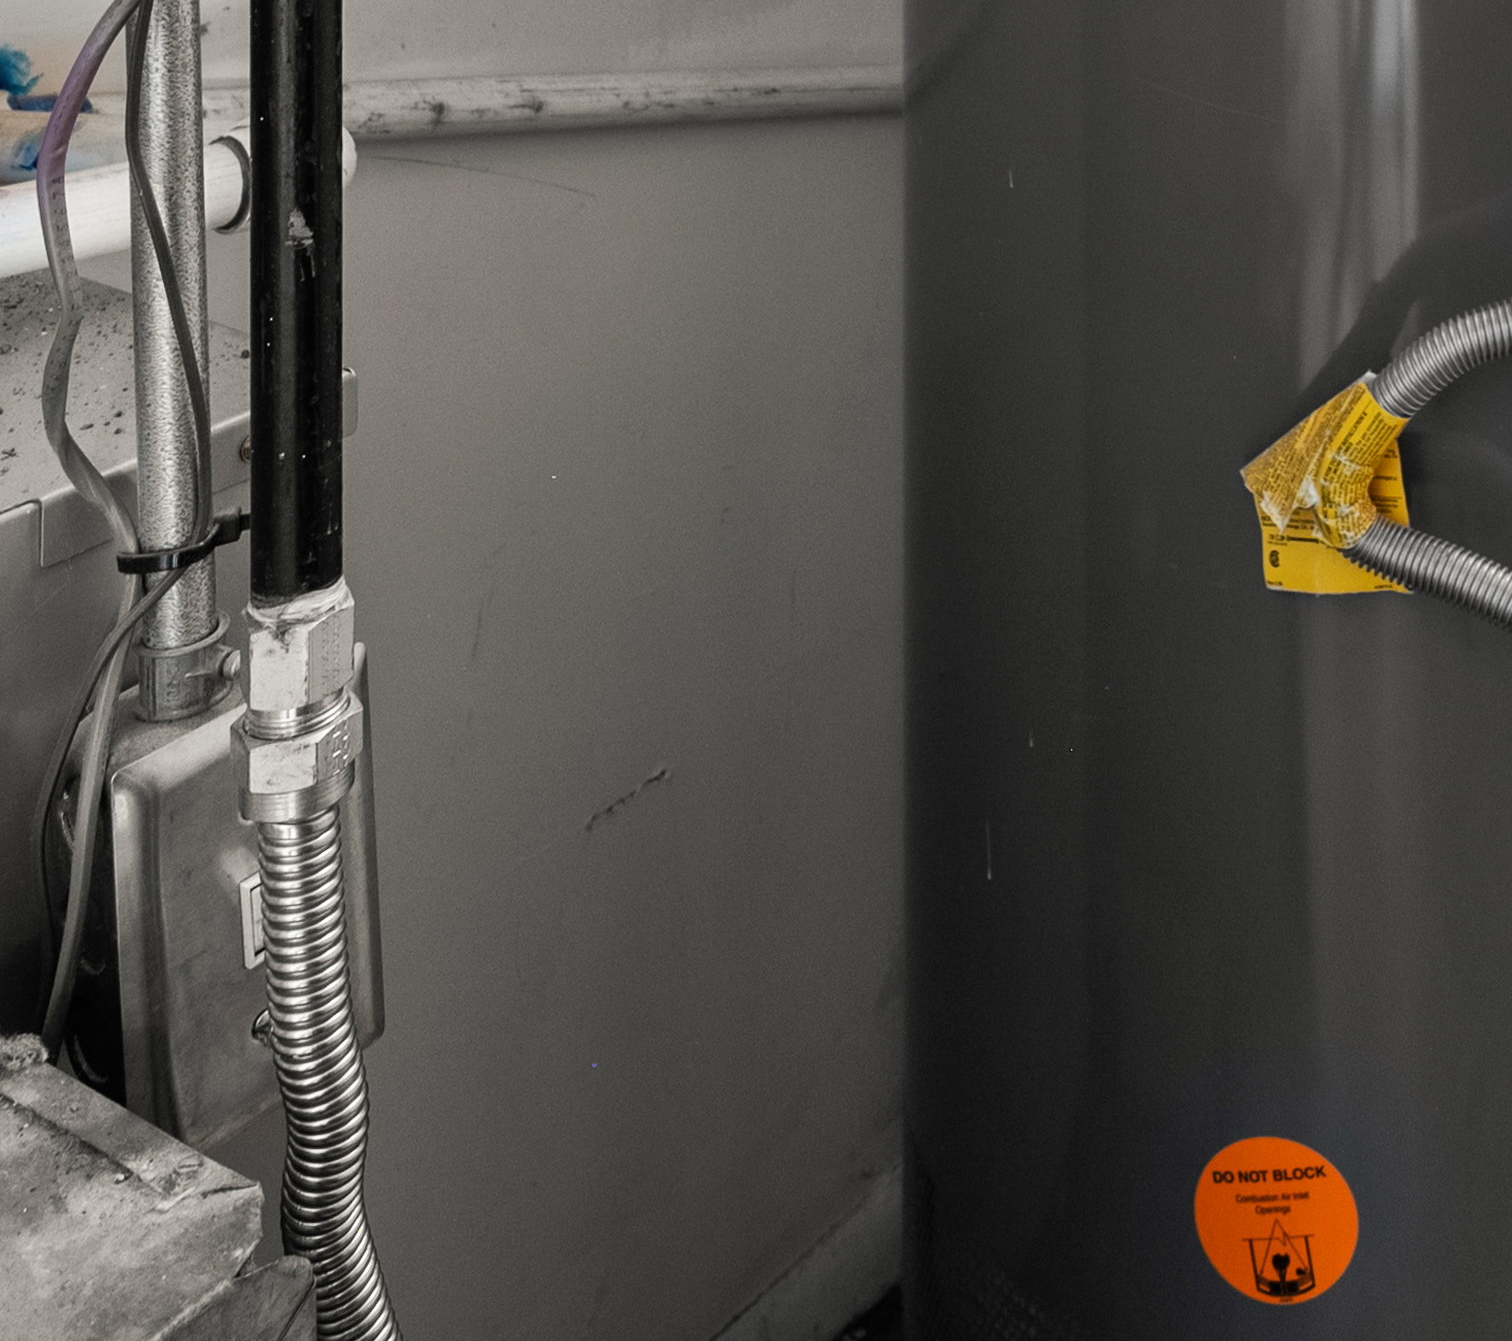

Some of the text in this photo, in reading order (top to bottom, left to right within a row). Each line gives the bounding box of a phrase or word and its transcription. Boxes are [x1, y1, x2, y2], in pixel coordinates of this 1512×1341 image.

[1212, 1166, 1327, 1184] DO NOT BLOCK
[1235, 1192, 1280, 1205] Combustion
[1281, 1191, 1291, 1202] Air
[1255, 1204, 1291, 1216] Openings
